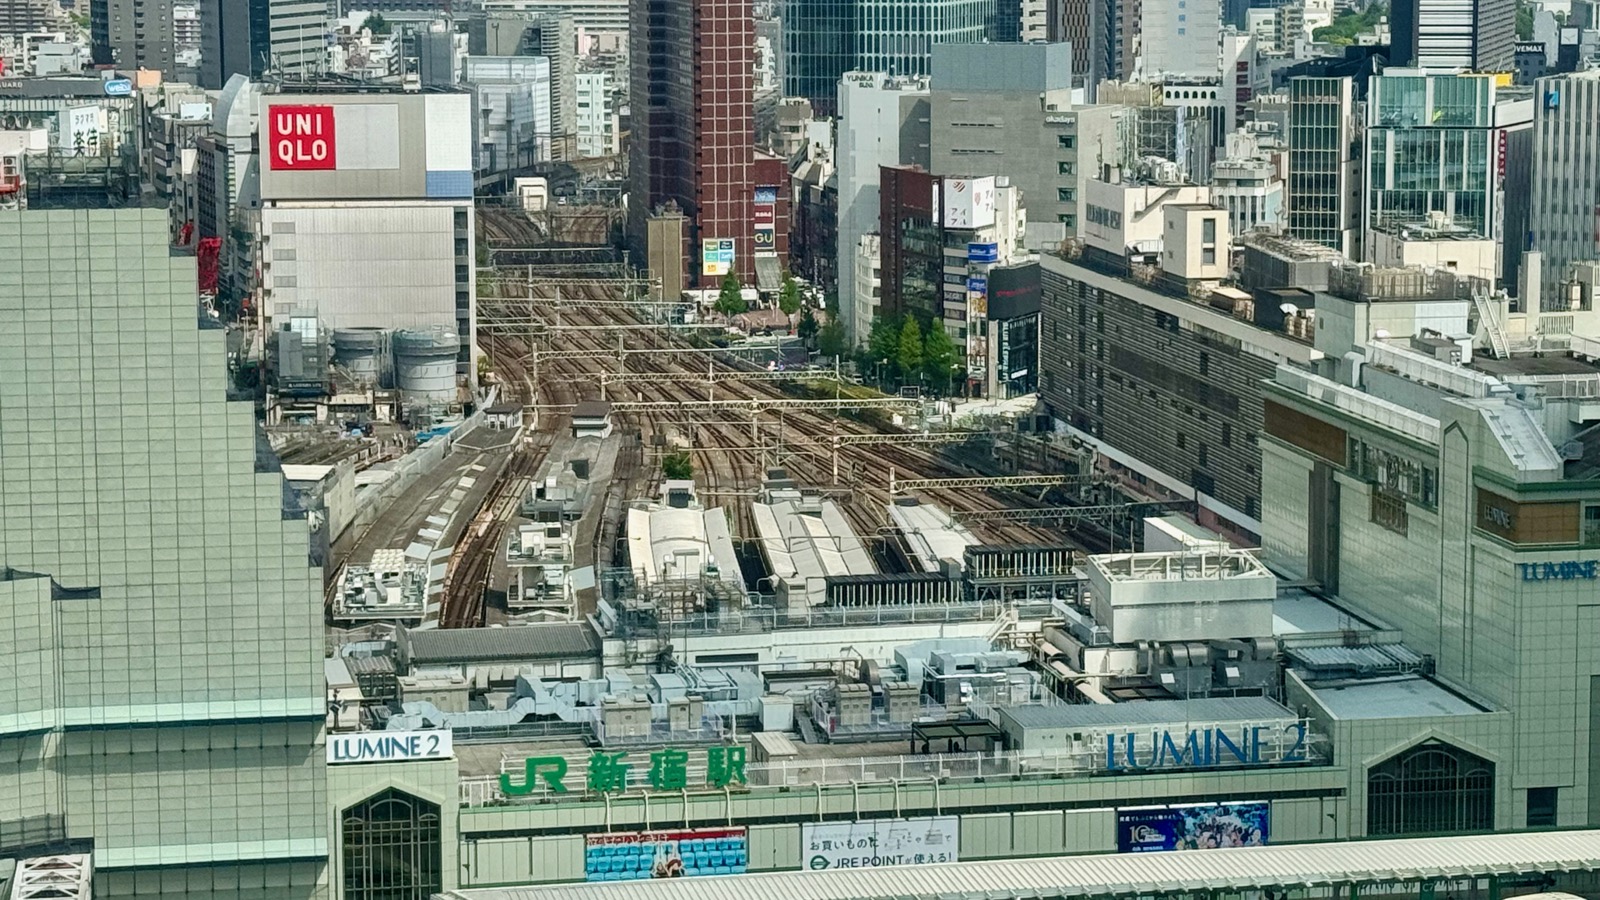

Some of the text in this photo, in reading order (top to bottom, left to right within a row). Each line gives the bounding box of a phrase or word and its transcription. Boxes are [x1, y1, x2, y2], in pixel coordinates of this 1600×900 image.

[0, 81, 23, 89] UARD
[277, 113, 322, 135] UNI
[278, 139, 327, 165] QLO
[755, 233, 773, 243] GU
[333, 734, 440, 760] LUMINE 2
[1107, 723, 1307, 769] LUMINE 2
[500, 747, 747, 795] JR 新宿駅
[833, 857, 859, 869] JRE
[862, 854, 904, 867] POINT
